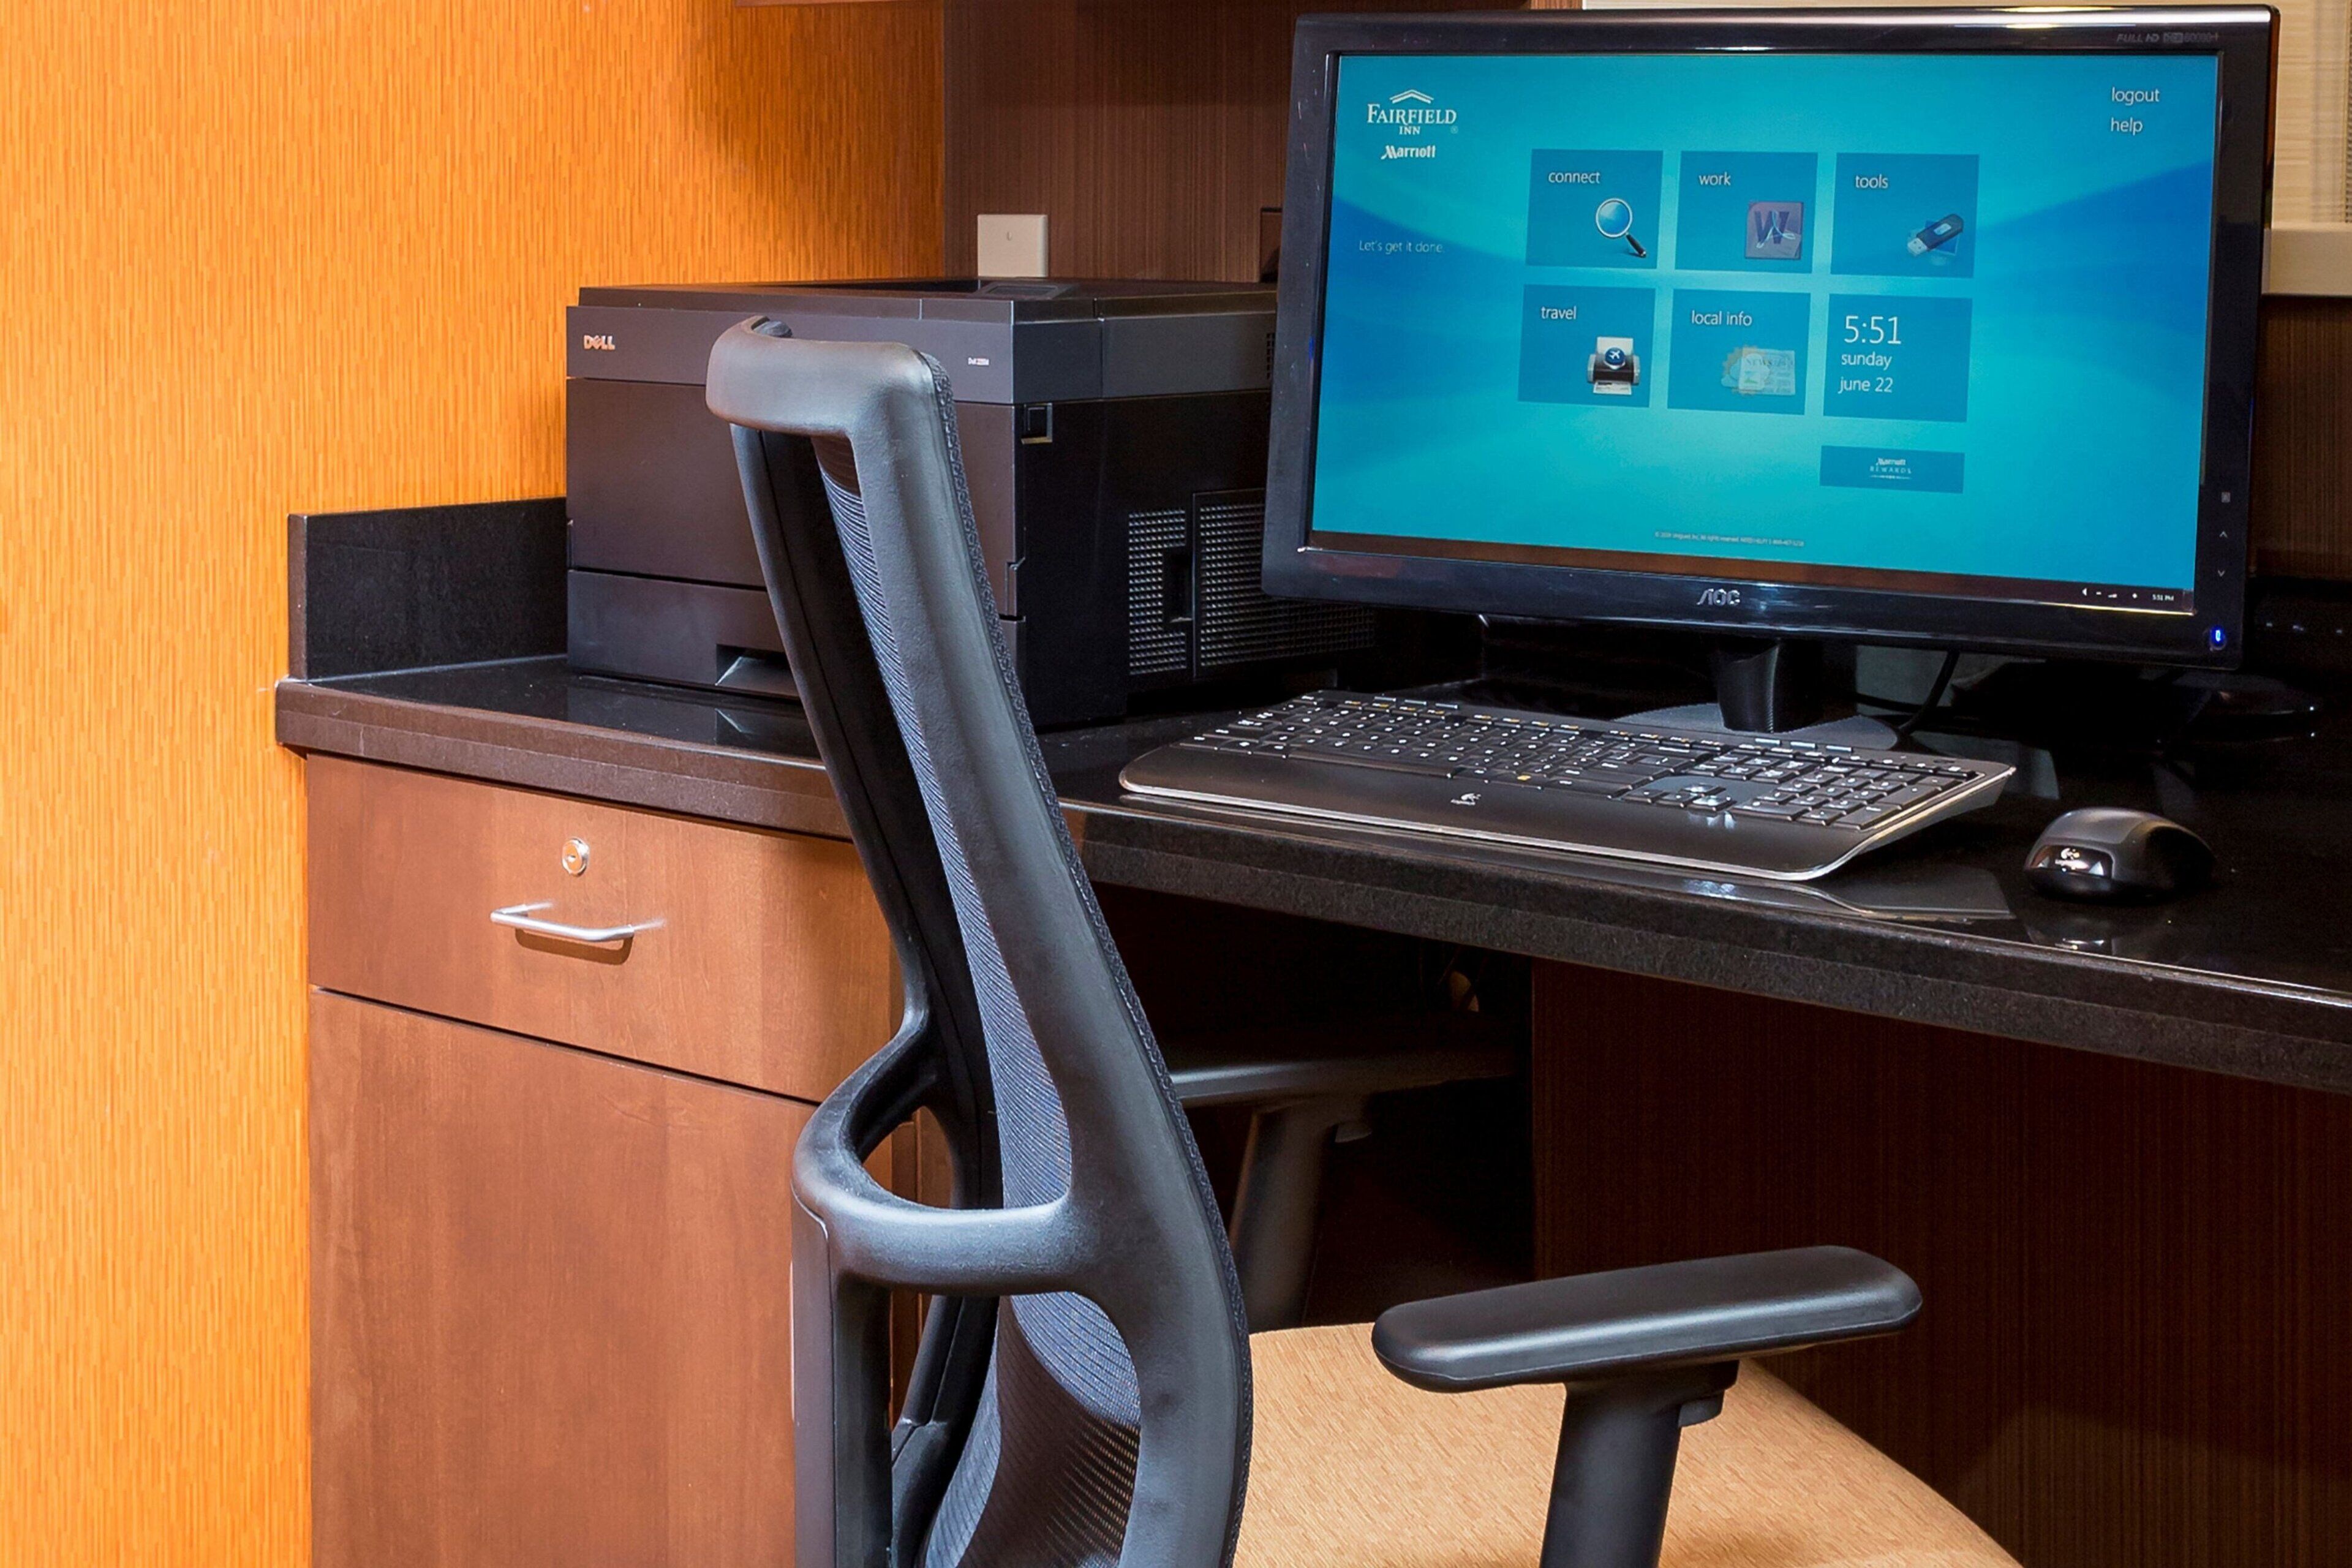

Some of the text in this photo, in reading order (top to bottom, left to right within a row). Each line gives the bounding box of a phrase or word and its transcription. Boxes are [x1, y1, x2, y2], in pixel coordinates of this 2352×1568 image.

[2116, 33, 2143, 42] FULL
[2146, 33, 2160, 42] HD
[2111, 86, 2160, 106] logout
[1367, 104, 1457, 126] FAIRFIELD
[1399, 126, 1420, 135] INN
[2111, 117, 2143, 135] help
[1381, 145, 1436, 160] Marriott
[1548, 172, 1600, 184] connect
[1699, 172, 1731, 186] work
[1855, 174, 1888, 189] tools
[1359, 240, 1382, 251] Let's
[1385, 243, 1403, 255] get
[1406, 241, 1412, 252] it
[1541, 306, 1577, 320] travel
[1691, 309, 1752, 326] local info
[1844, 315, 1901, 344] 5:51
[584, 334, 616, 350] DELL
[1841, 351, 1893, 371] sunday
[1838, 377, 1894, 394] june 22
[1697, 589, 1741, 606] AOC
